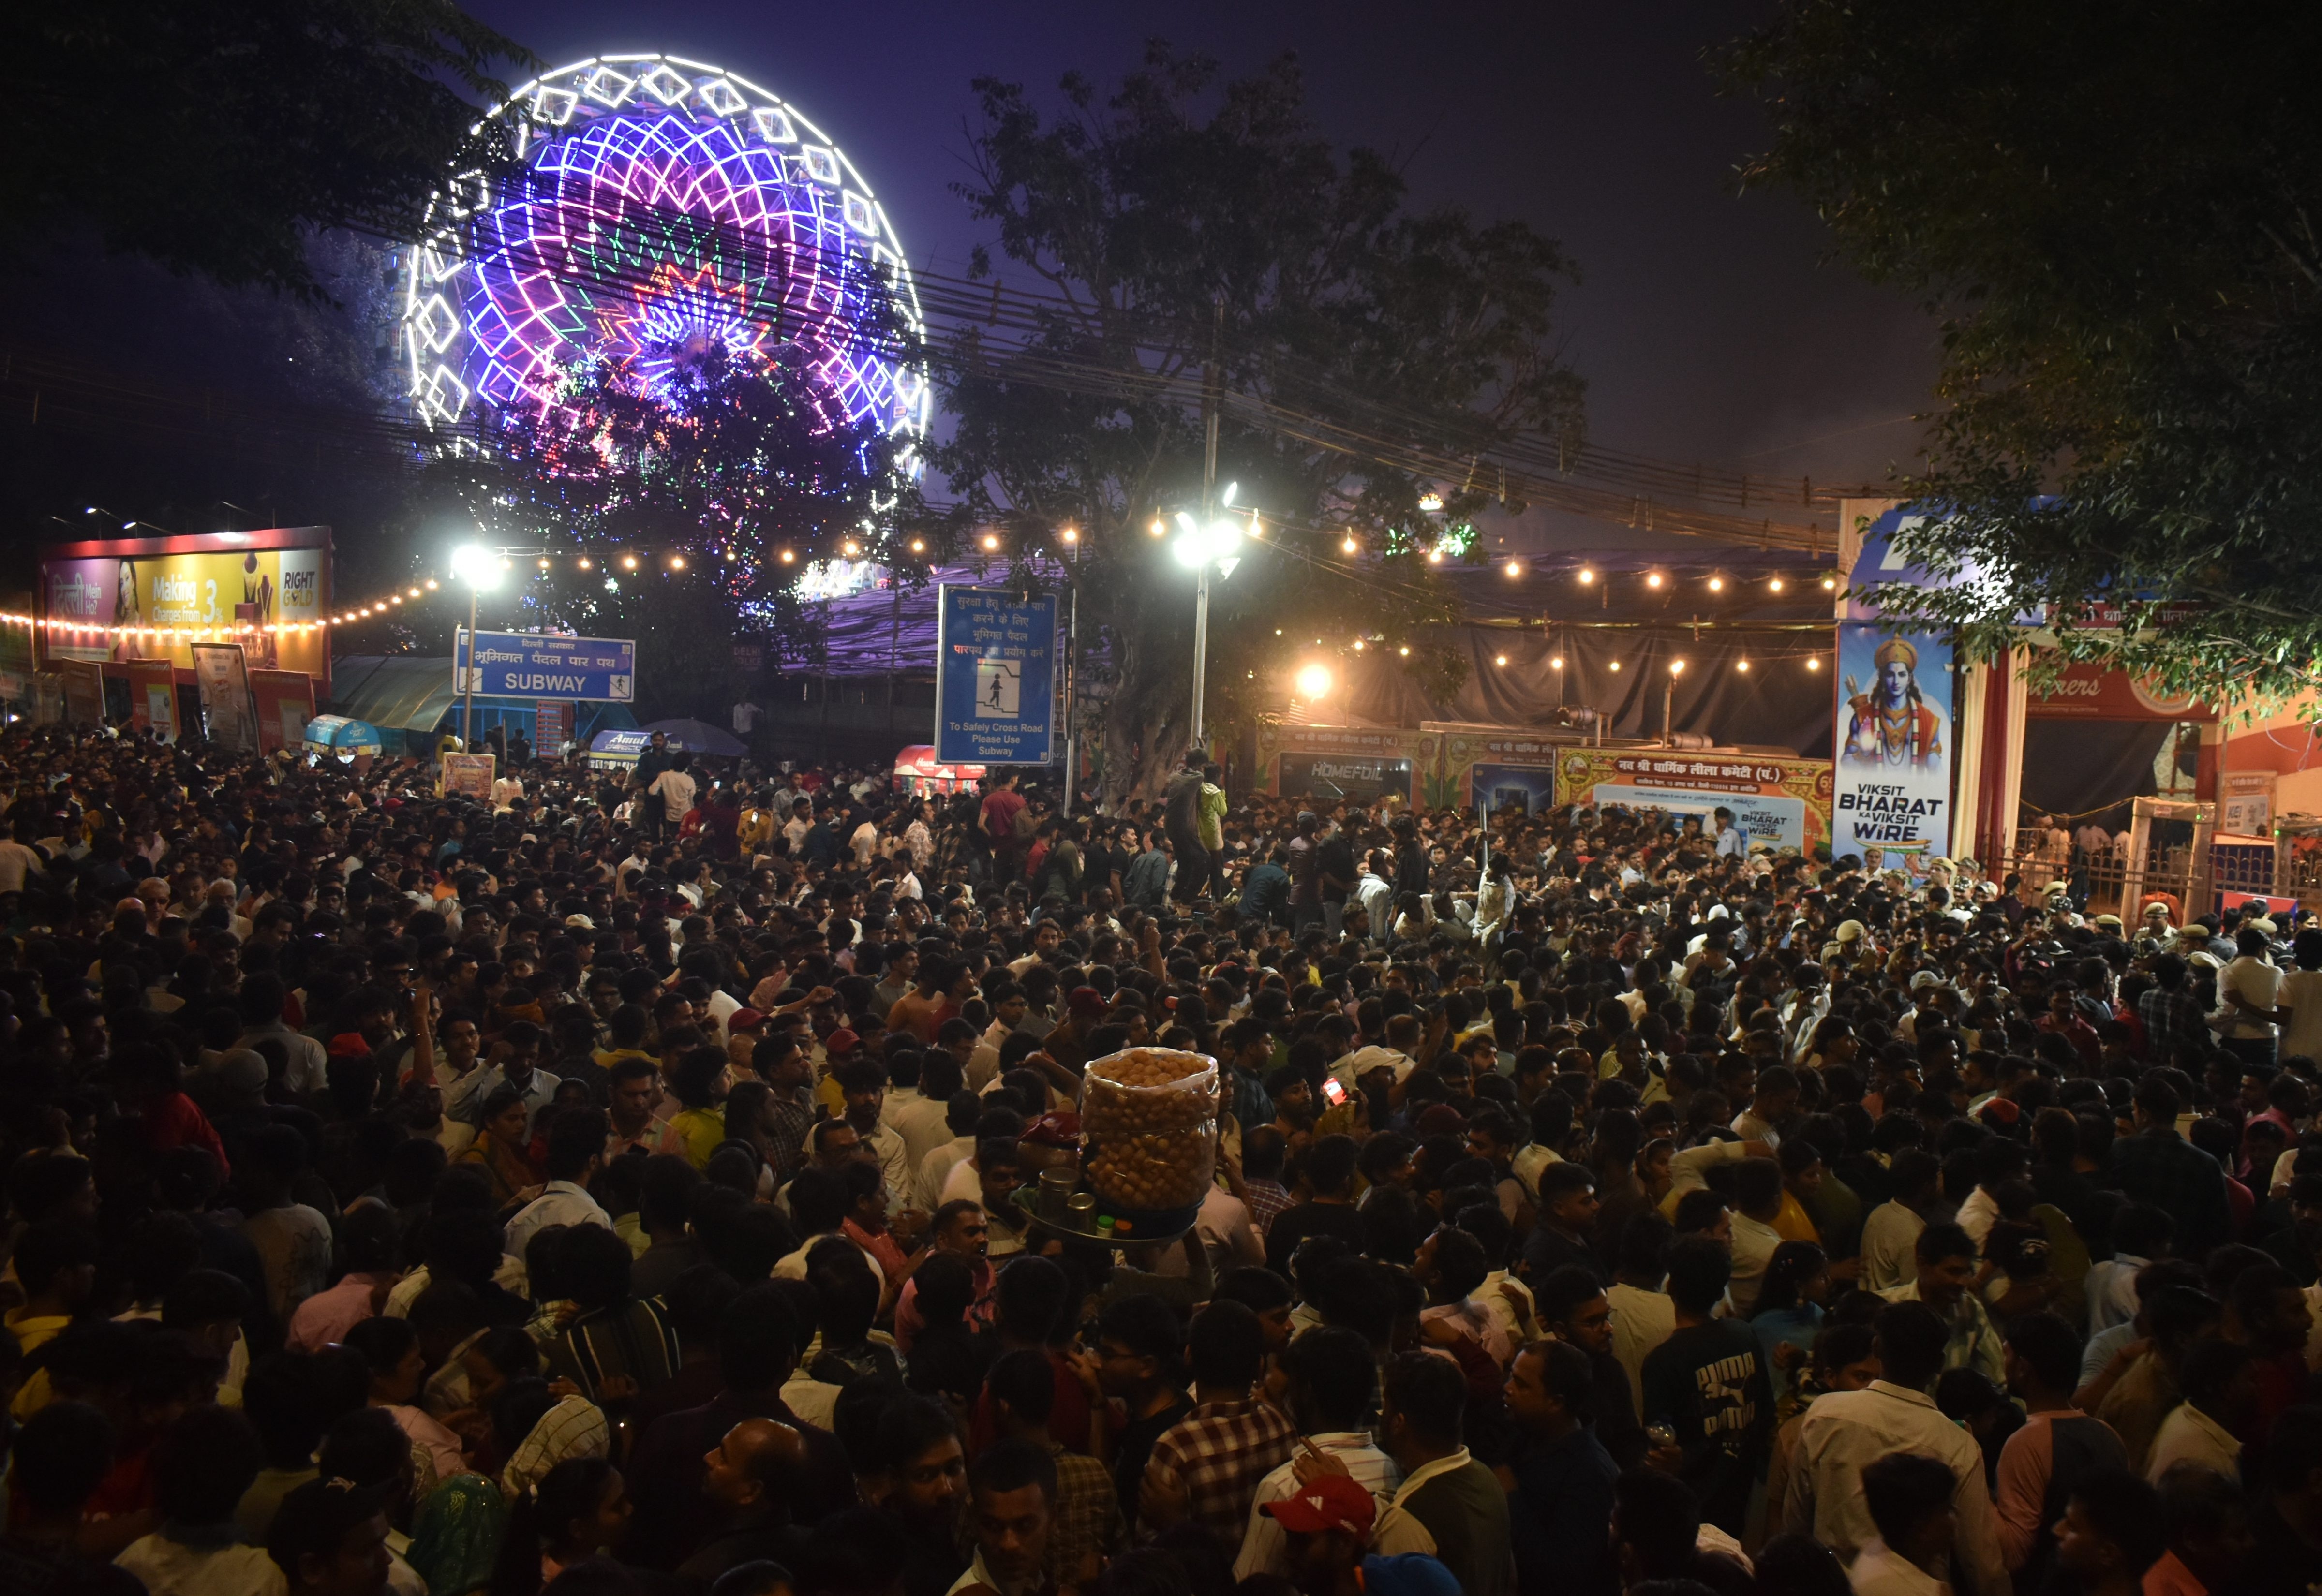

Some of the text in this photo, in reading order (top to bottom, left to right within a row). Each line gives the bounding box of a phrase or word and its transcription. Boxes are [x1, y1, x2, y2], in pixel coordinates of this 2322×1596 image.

[284, 571, 315, 589] RIGHT
[52, 572, 84, 614] दिल्ली
[85, 582, 102, 599] Mein
[153, 574, 197, 607] Making
[283, 589, 313, 607] GOLD
[85, 600, 97, 615] Ho?
[1031, 602, 1046, 611] पार
[153, 606, 200, 625] Charges from
[973, 612, 1029, 628] करने के लिए
[972, 627, 1028, 643] भूमिगत पैदल
[521, 638, 575, 650] दिल्ली सरकार
[953, 644, 982, 655] पारपथ
[1003, 645, 1026, 657] प्रयोग
[475, 648, 616, 668] भूमिगत पैदल पार पथ
[505, 672, 587, 692] SUBWAY
[949, 722, 1043, 733] To Safely Cross Road
[609, 733, 648, 745] Amul
[666, 740, 683, 749] Amul
[972, 734, 1021, 744] Please Use
[978, 746, 1013, 757] Subway
[1311, 763, 1383, 782] HOMEFOIL
[1618, 759, 1781, 783] नव श्री धार्मिक लीला कमेटी (पं.)
[1858, 783, 1905, 796] VIKSIT
[1839, 793, 1944, 816] BHARAT
[1742, 814, 1787, 825] BHARAT
[1872, 813, 1920, 825] VIKSIT
